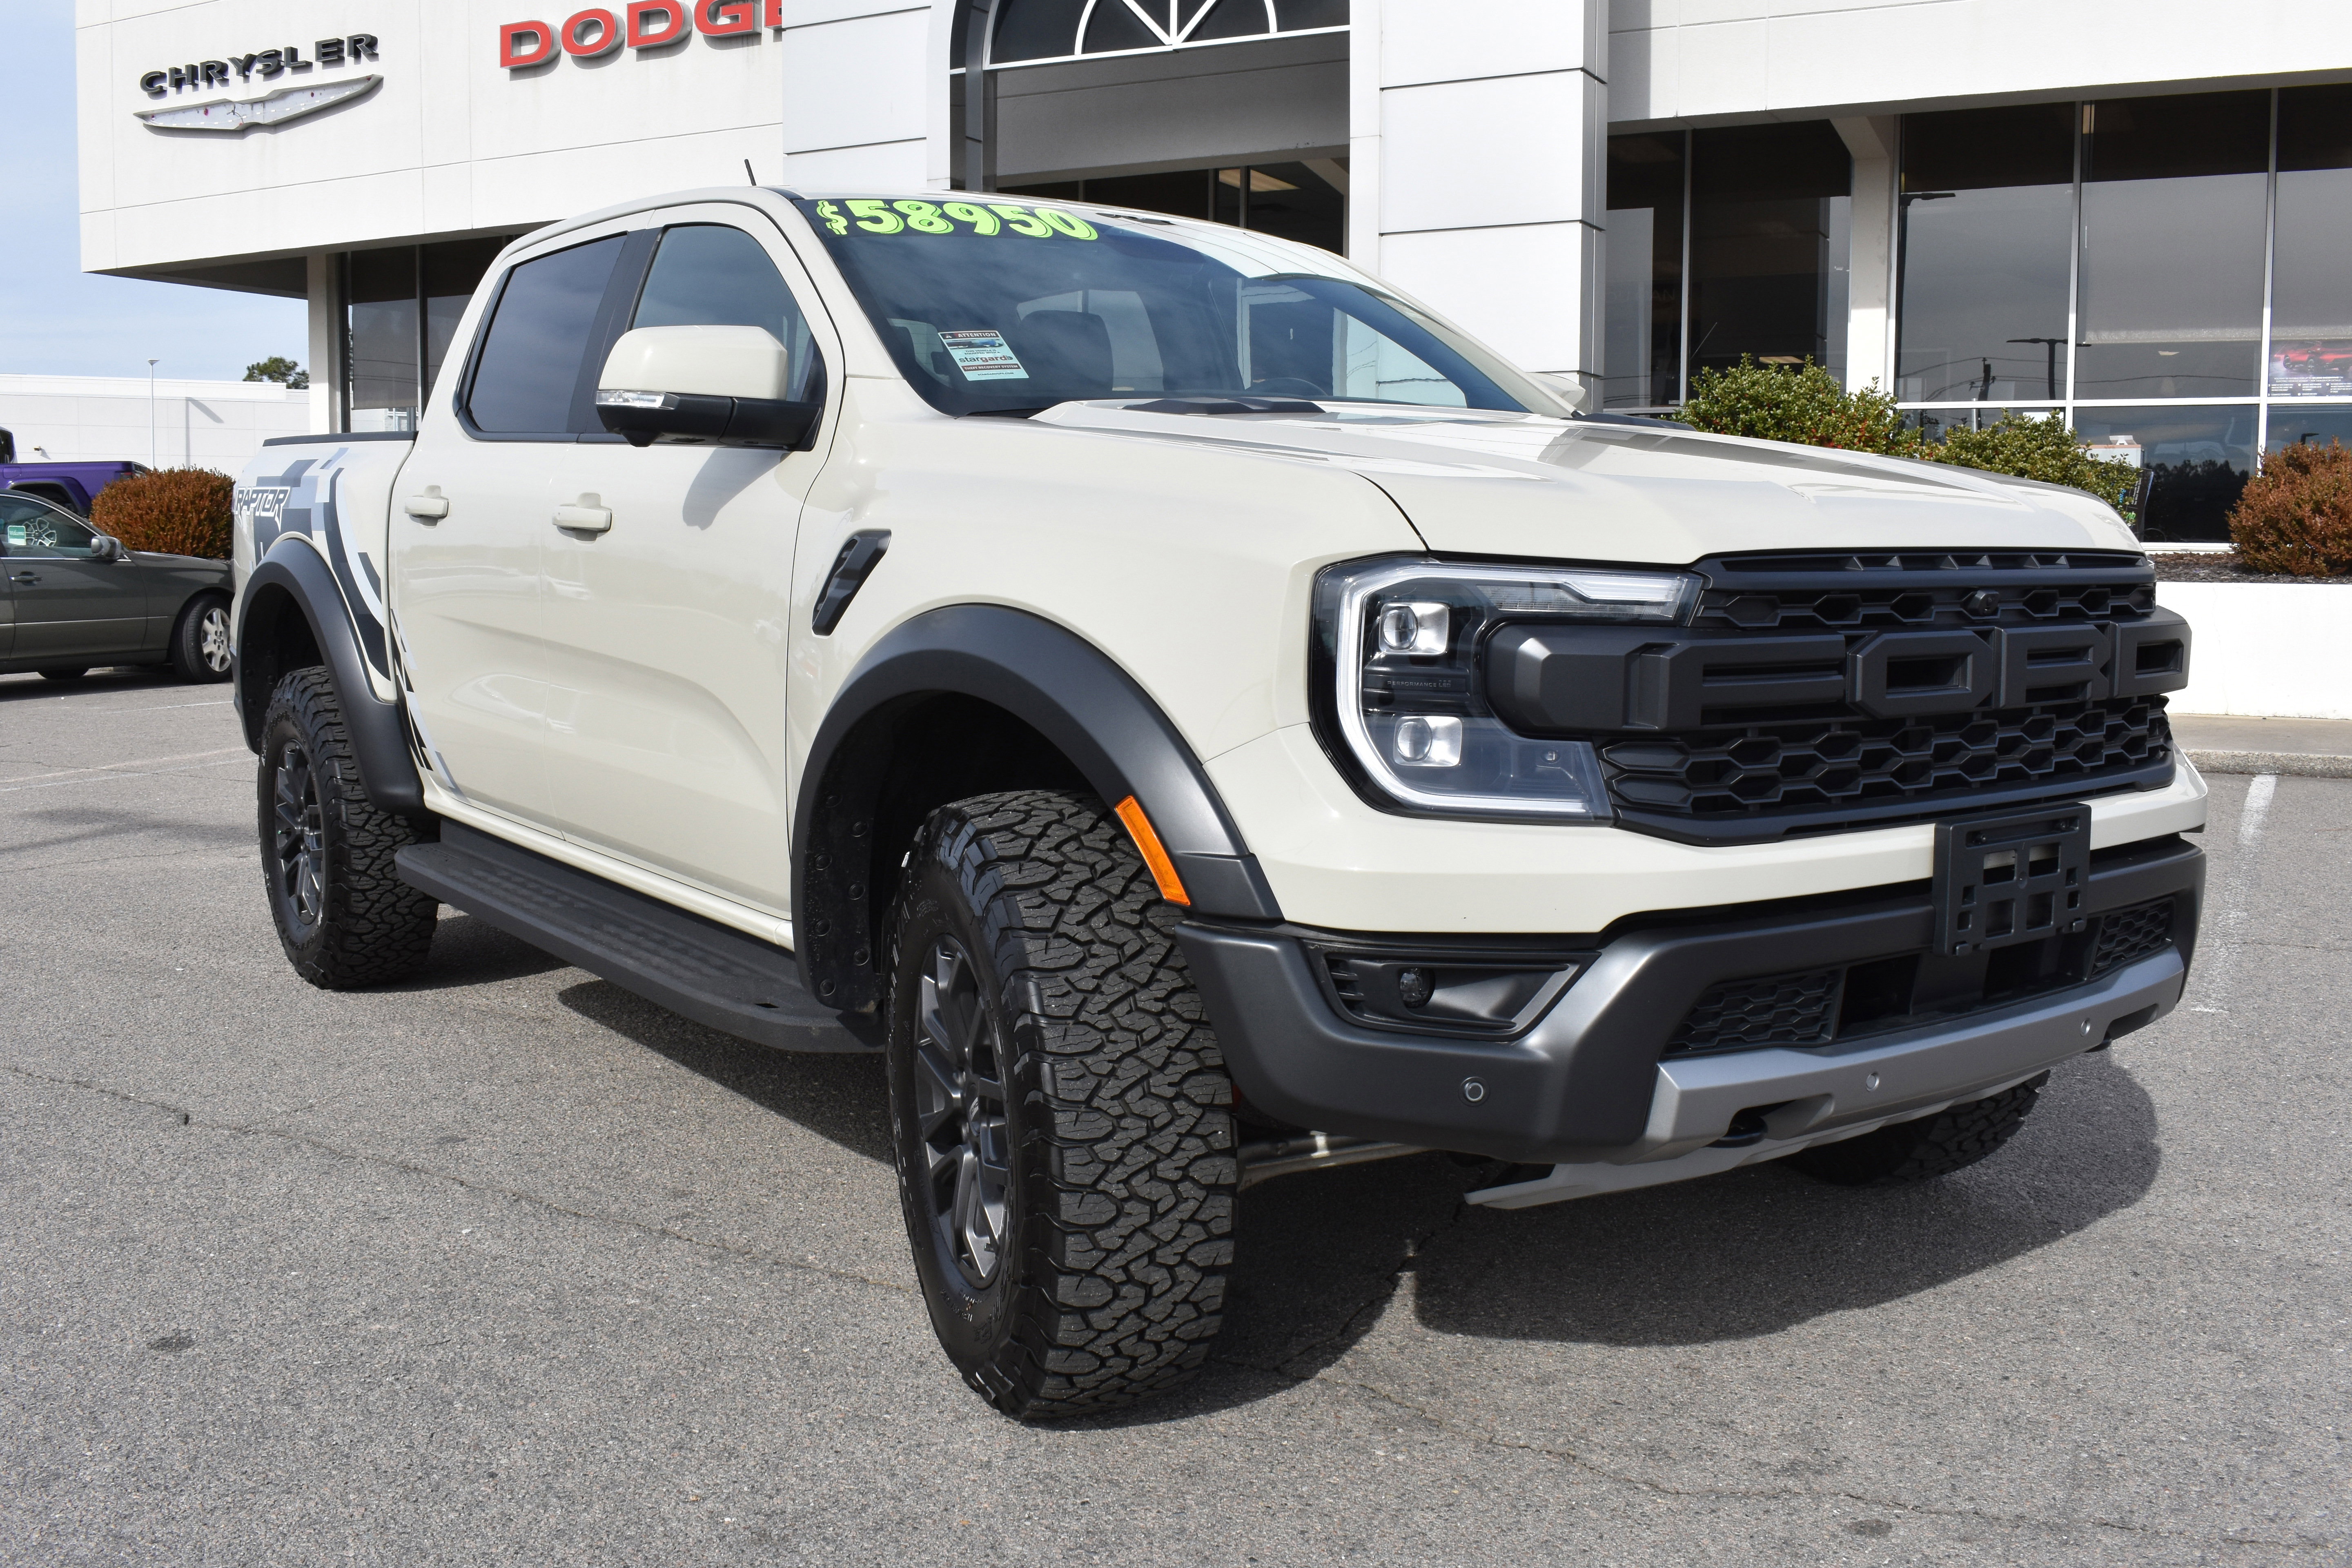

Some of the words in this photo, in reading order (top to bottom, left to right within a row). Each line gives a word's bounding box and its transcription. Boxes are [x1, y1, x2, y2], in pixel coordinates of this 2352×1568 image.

[140, 33, 378, 94] CHRYSLER
[499, 0, 783, 69] DODG
[817, 200, 1098, 241] $58950
[234, 486, 290, 532] RAPTOR
[1623, 608, 2192, 730] FORD
